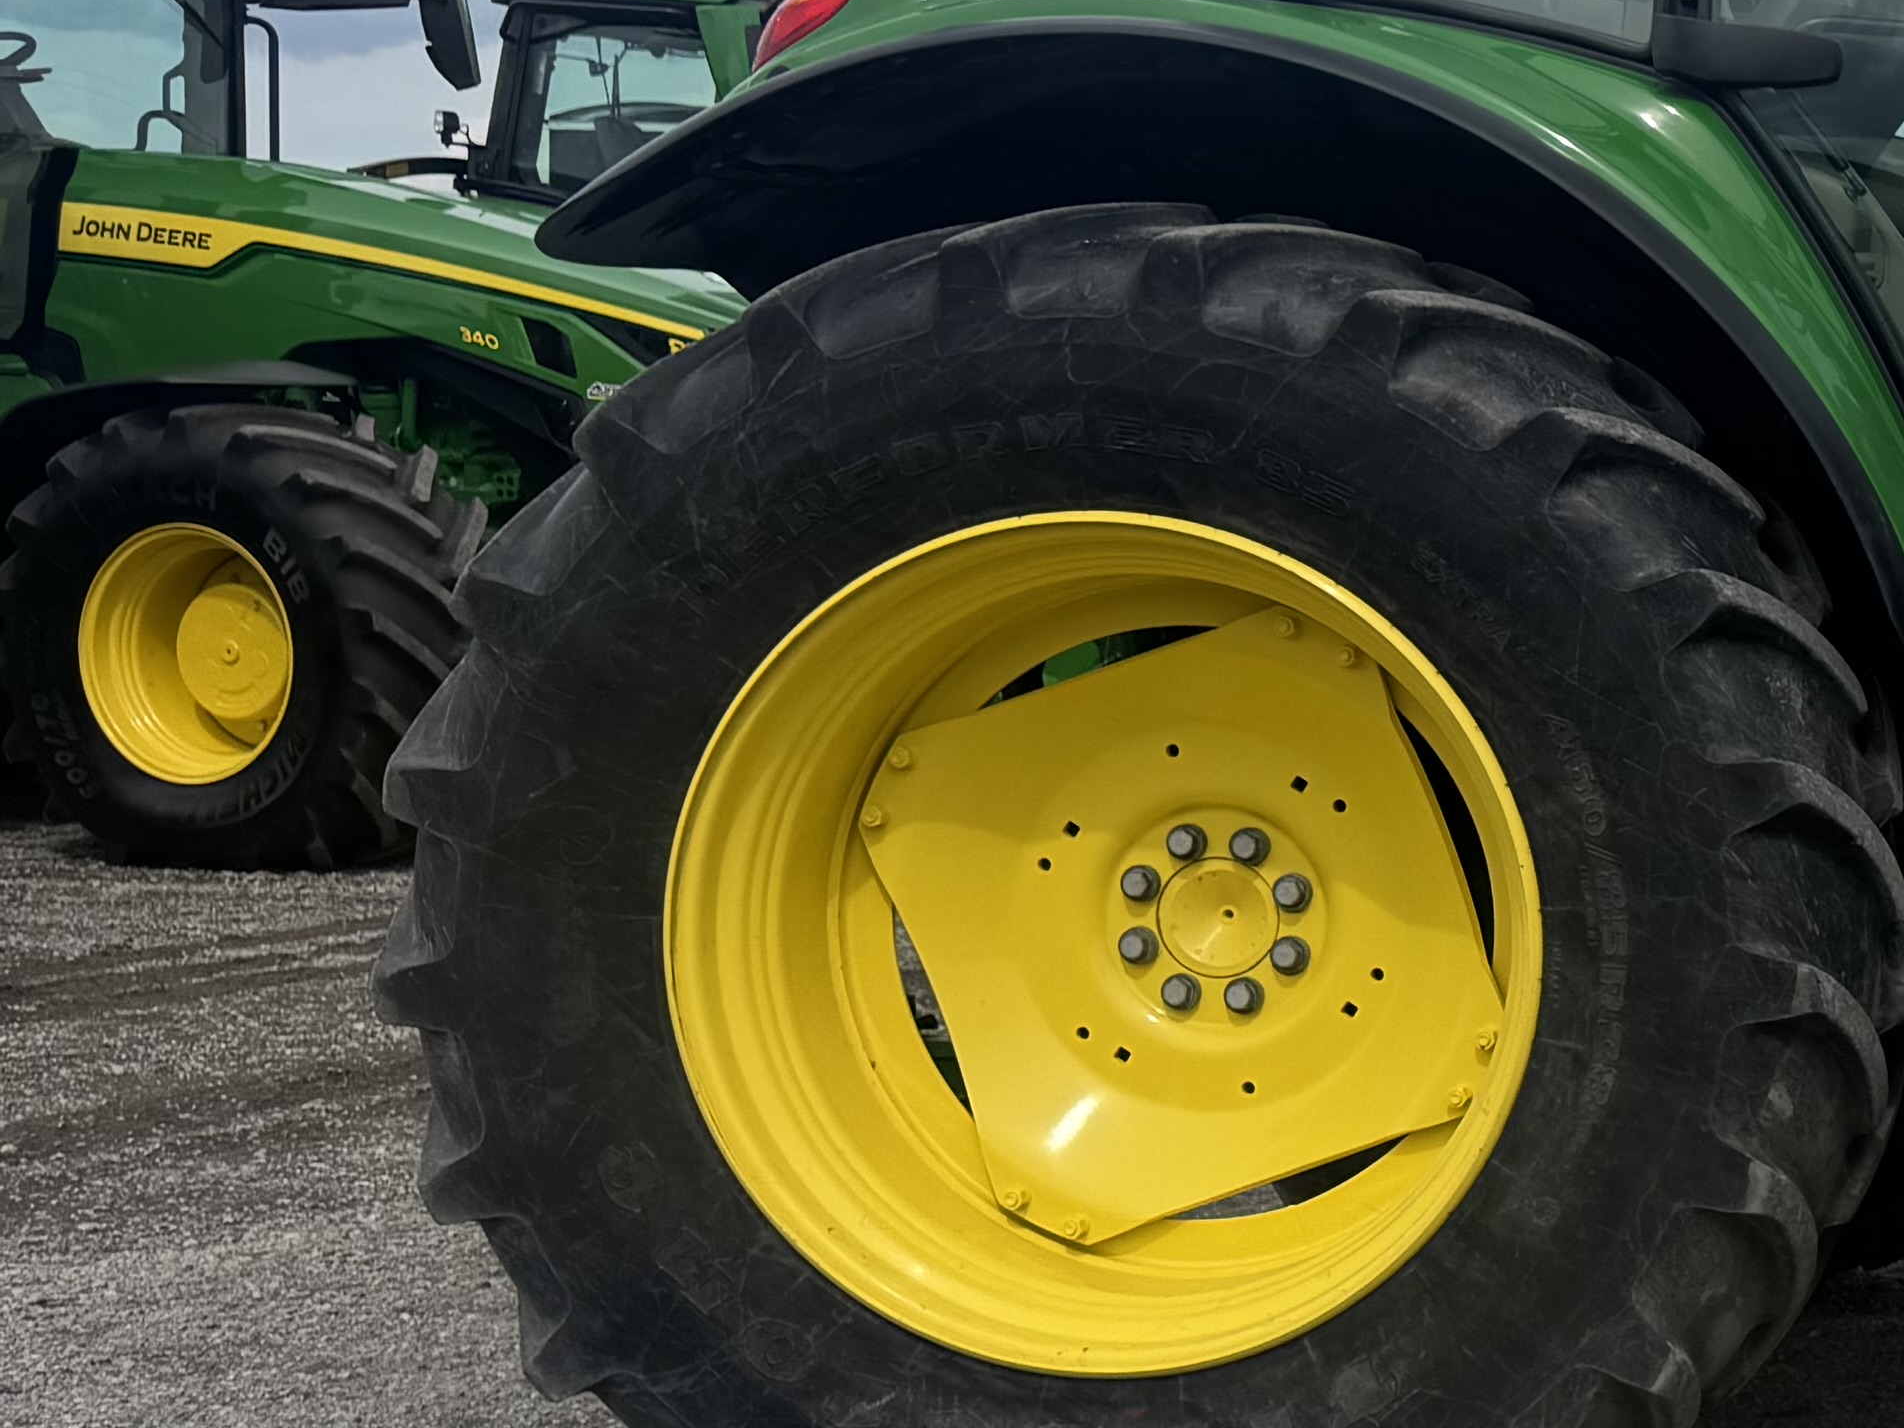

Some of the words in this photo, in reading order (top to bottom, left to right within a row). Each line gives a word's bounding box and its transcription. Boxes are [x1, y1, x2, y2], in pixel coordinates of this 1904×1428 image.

[72, 215, 132, 241] JOHN
[136, 221, 212, 251] DEERE
[459, 325, 499, 350] 340
[262, 524, 312, 604] BIB
